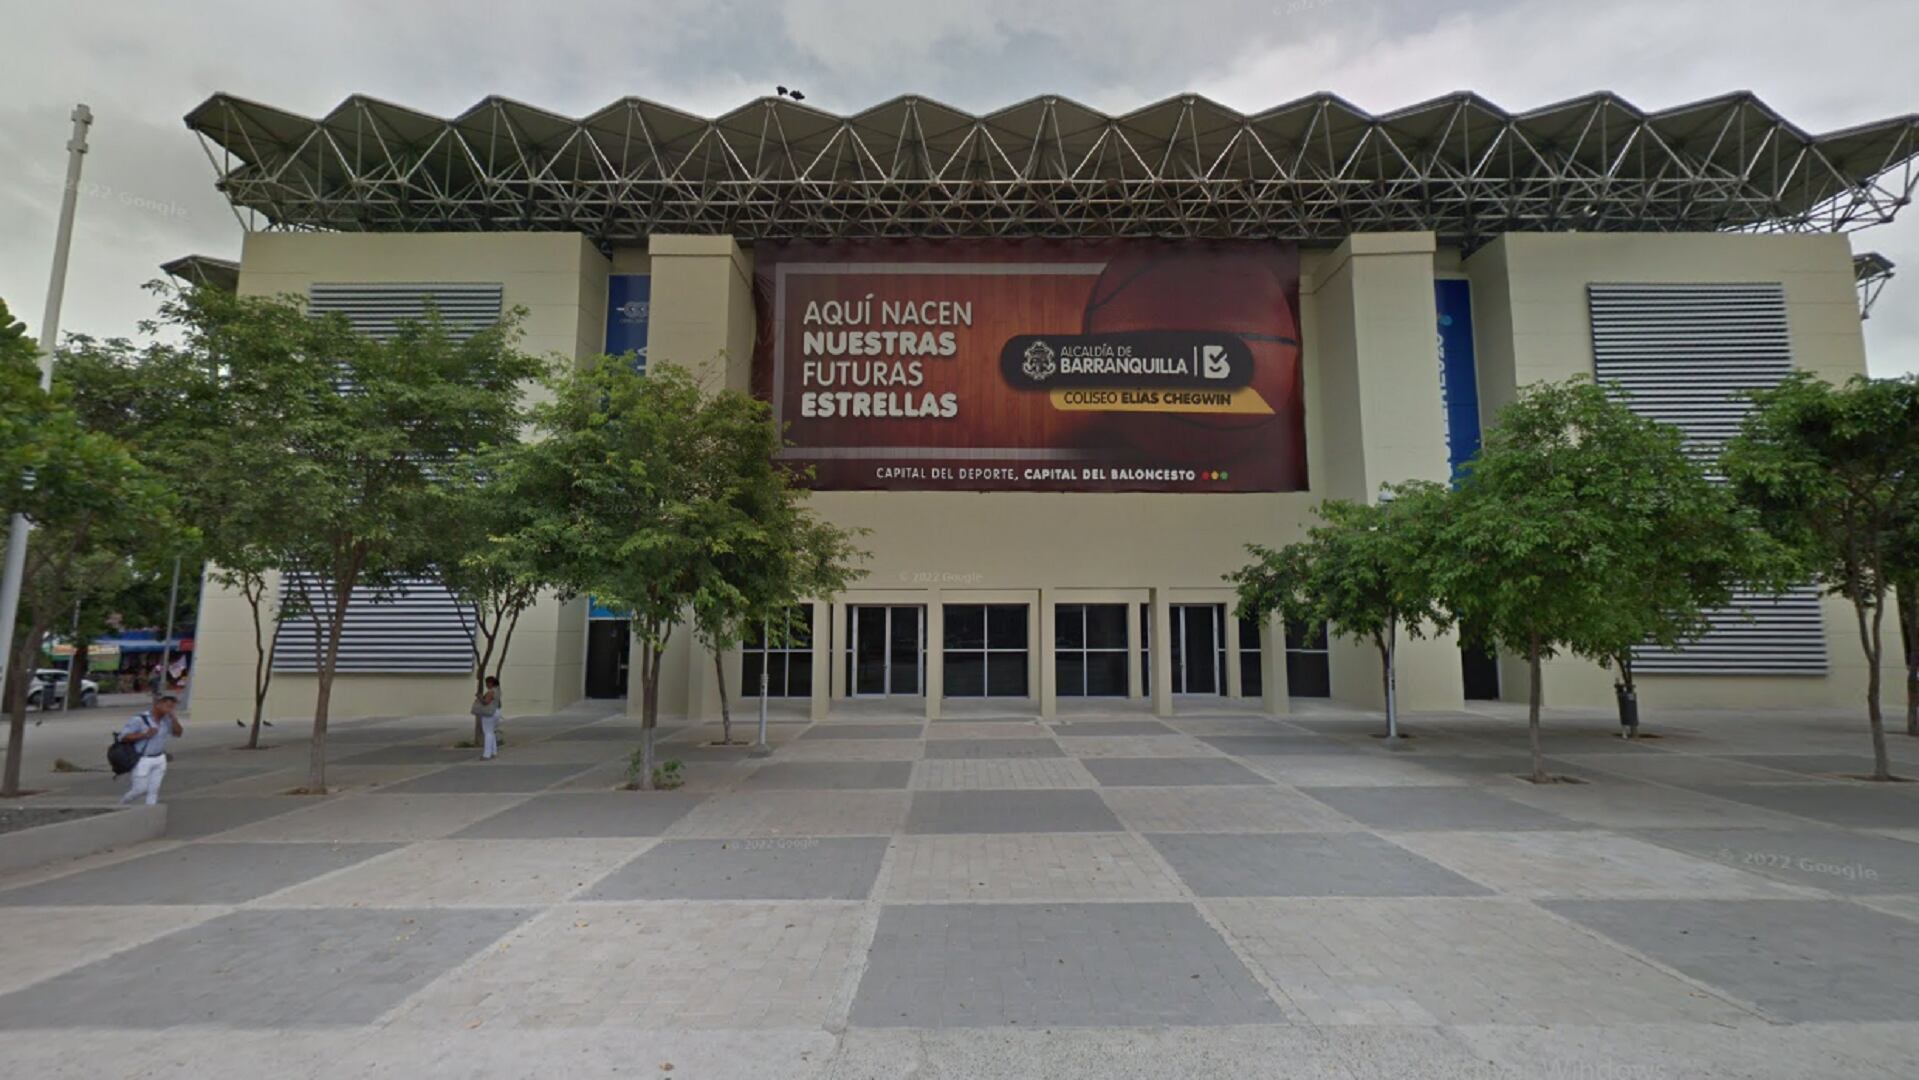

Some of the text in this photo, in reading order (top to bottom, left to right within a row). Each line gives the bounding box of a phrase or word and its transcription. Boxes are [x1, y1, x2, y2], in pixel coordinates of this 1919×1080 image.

[803, 293, 972, 326] AQUÍ NACEN
[803, 331, 956, 356] NUESTRAS
[1060, 343, 1132, 357] ALCALDÍA DE
[803, 361, 924, 386] FUTURAS
[1060, 357, 1188, 376] BARRANQUILLA
[801, 392, 958, 418] ESTRELLAS
[1064, 387, 1231, 405] COLISEO ELÍAS CHEGWIN
[876, 467, 1196, 481] CAPITAL DEL DEPORTE, CAPITAL DEL BALONCESTO
